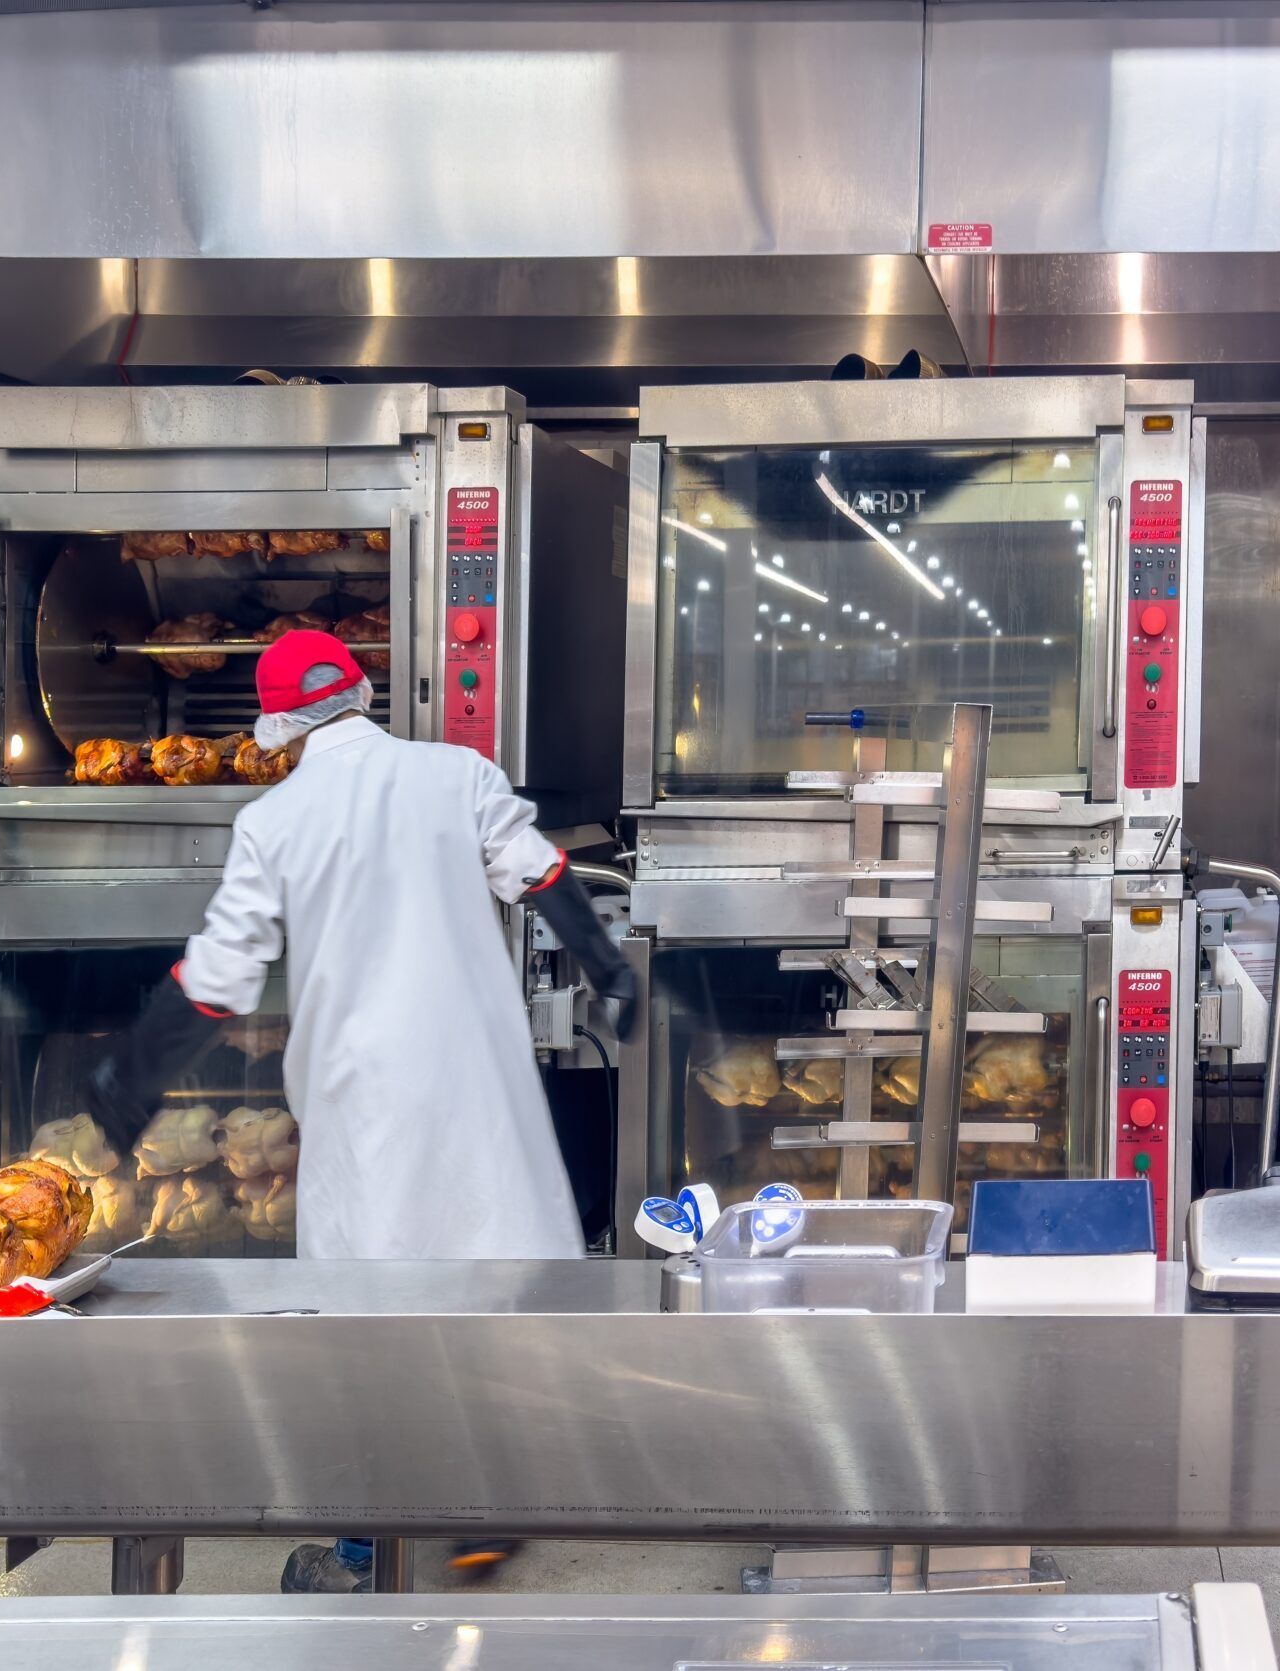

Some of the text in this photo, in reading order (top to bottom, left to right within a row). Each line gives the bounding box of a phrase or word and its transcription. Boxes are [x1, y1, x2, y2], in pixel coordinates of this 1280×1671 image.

[1139, 483, 1174, 492] INFERNO
[457, 490, 490, 499] INFERNO
[1140, 493, 1173, 502] 4500
[457, 501, 489, 510] 4500
[1128, 972, 1162, 980] INFERNO
[1128, 982, 1160, 991] 4500
